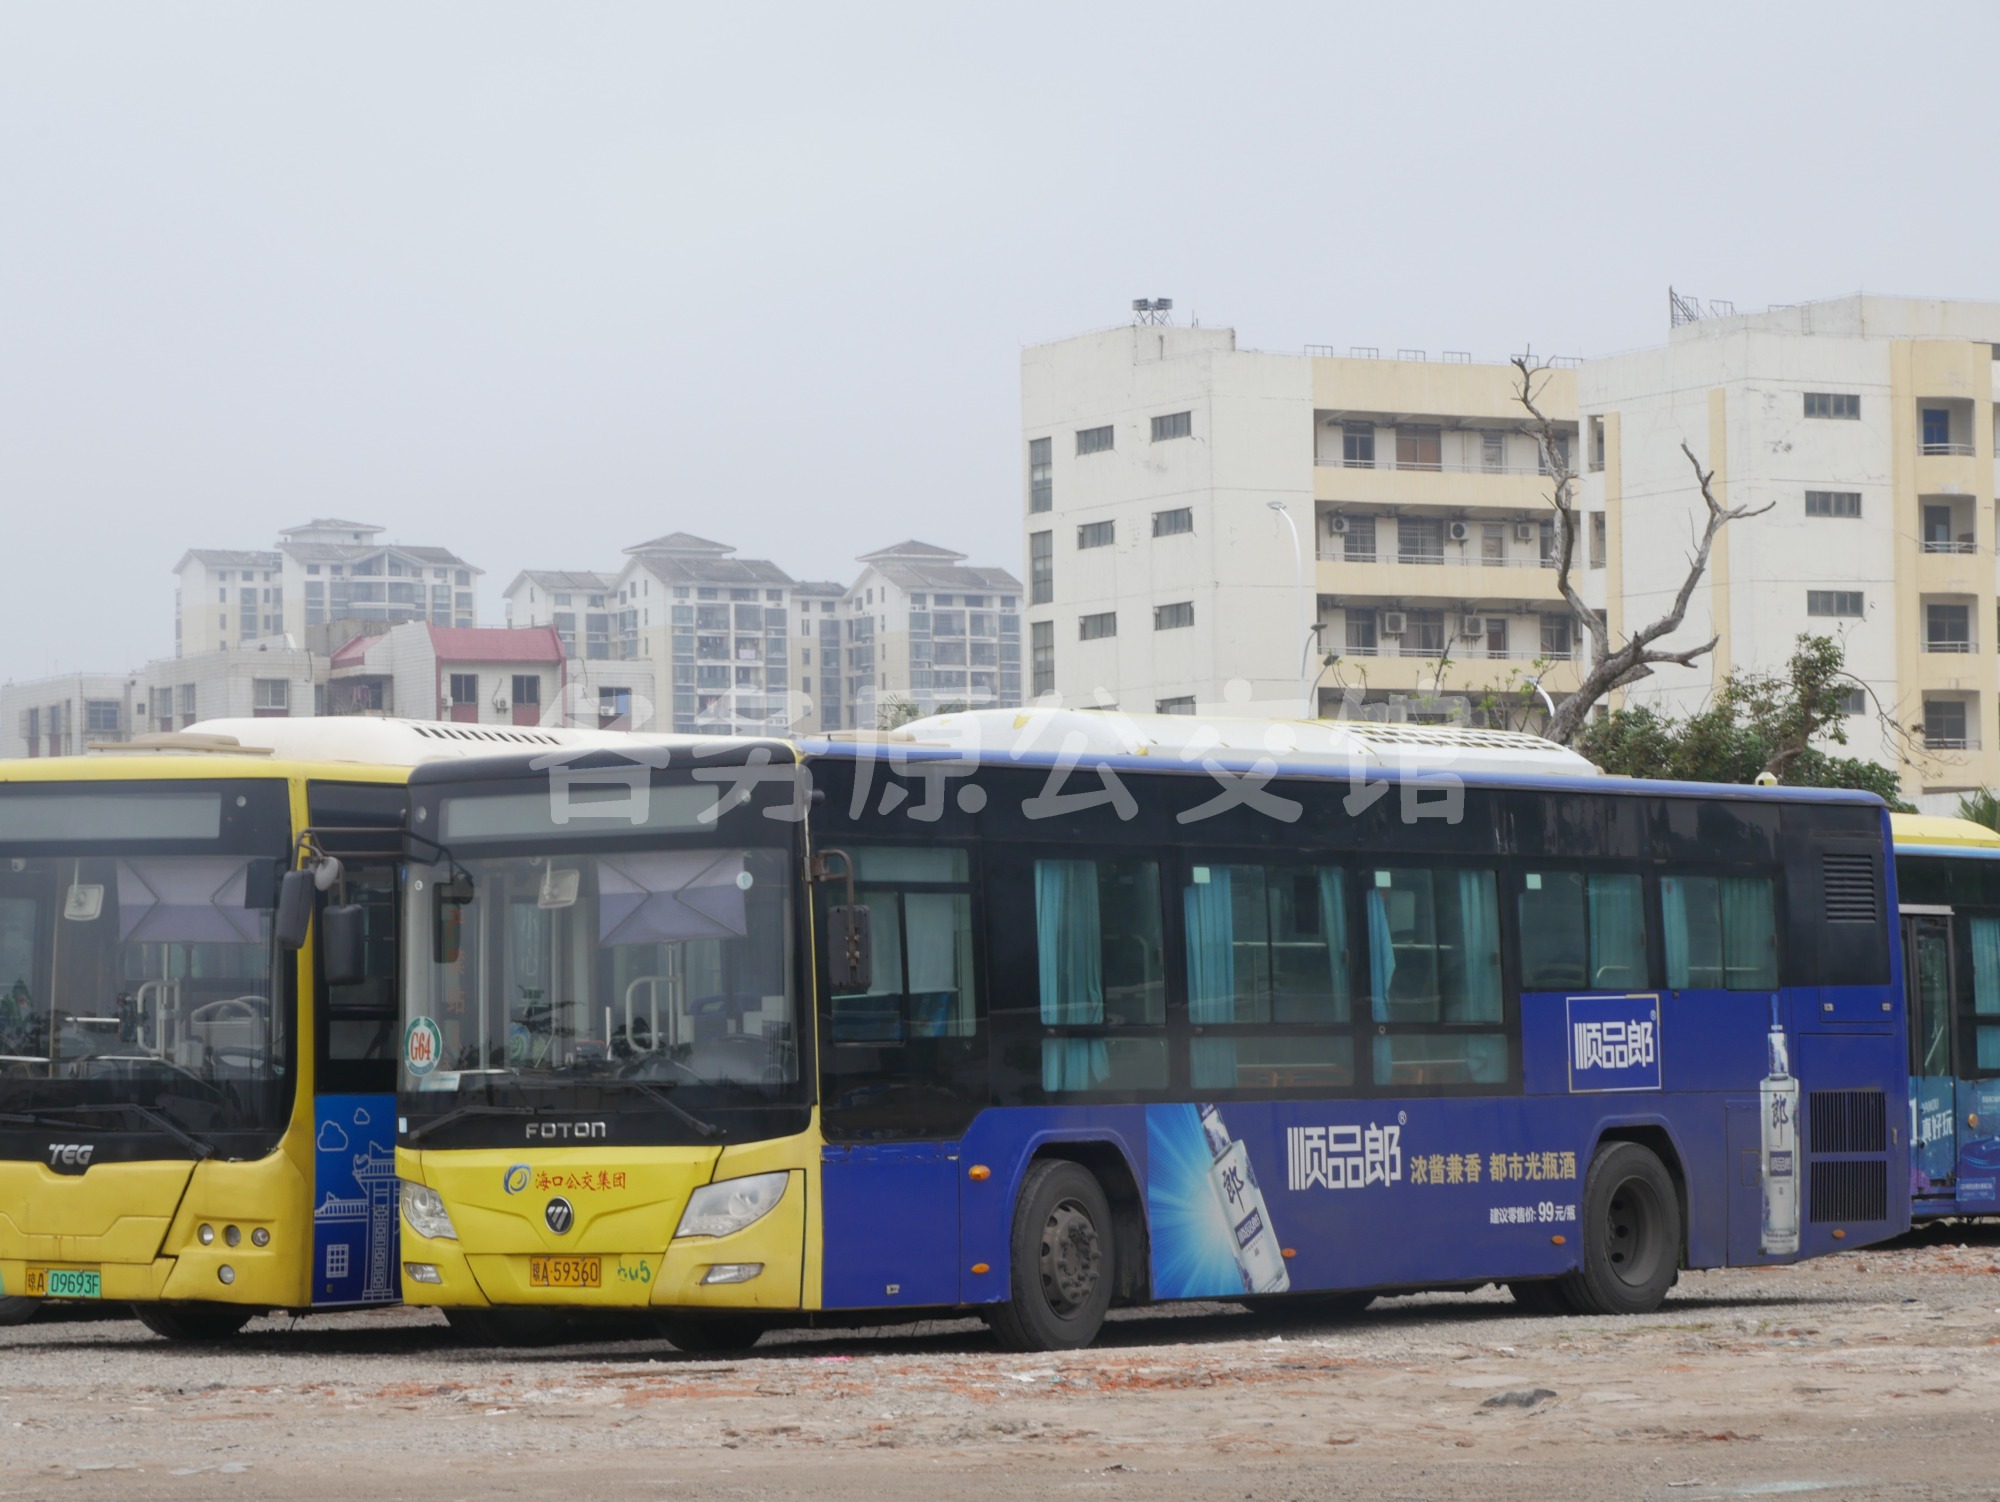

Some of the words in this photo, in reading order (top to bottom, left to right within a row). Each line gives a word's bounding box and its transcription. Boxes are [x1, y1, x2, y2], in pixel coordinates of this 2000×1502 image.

[410, 1031, 431, 1061] G64
[1574, 1019, 1654, 1070] 顺品郎
[526, 1122, 606, 1139] FOTON
[49, 1144, 94, 1165] TEG
[1287, 1121, 1402, 1191] 顺品郎
[1410, 1153, 1482, 1185] 浓酱兼香
[1489, 1151, 1577, 1182] 都市光瓶酒
[535, 1170, 626, 1192] 海口公交集团
